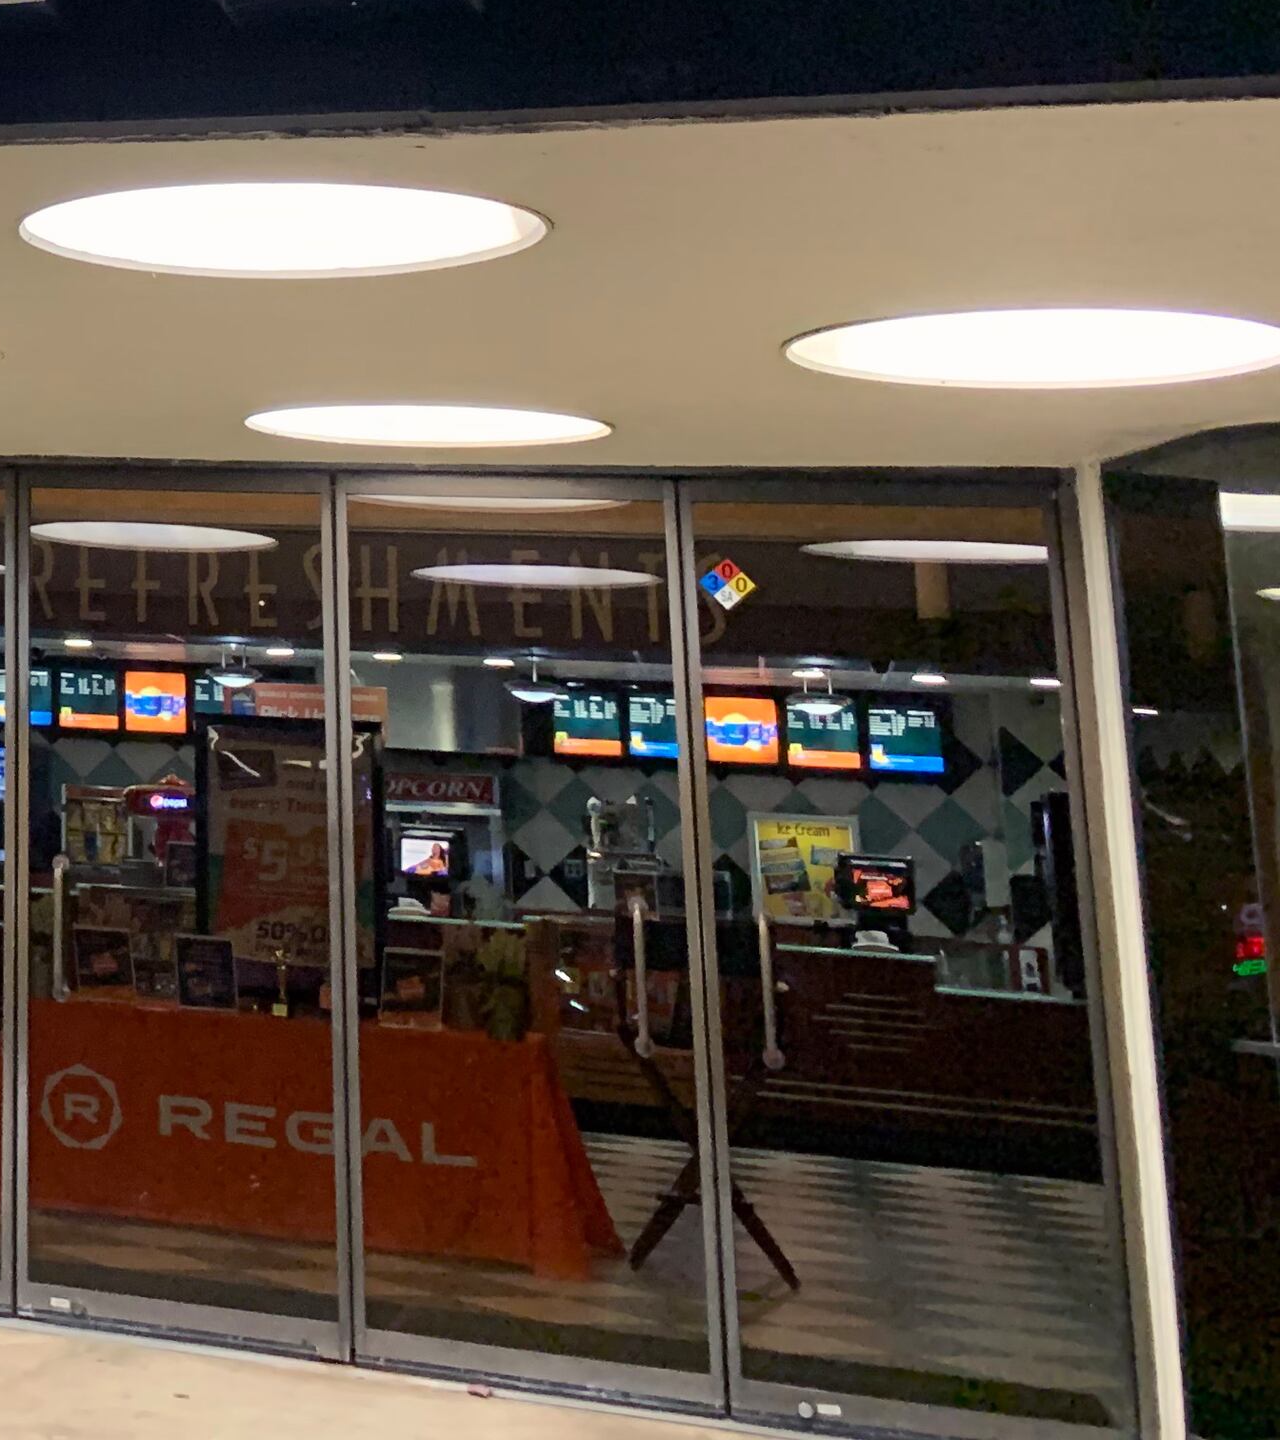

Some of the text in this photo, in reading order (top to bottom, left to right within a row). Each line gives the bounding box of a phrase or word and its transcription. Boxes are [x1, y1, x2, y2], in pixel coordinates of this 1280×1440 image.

[721, 563, 733, 579] 0
[708, 575, 748, 592] 3 0
[386, 777, 487, 798] OPCORN
[777, 822, 830, 837] Ice Cream
[157, 1093, 478, 1168] REGAL
